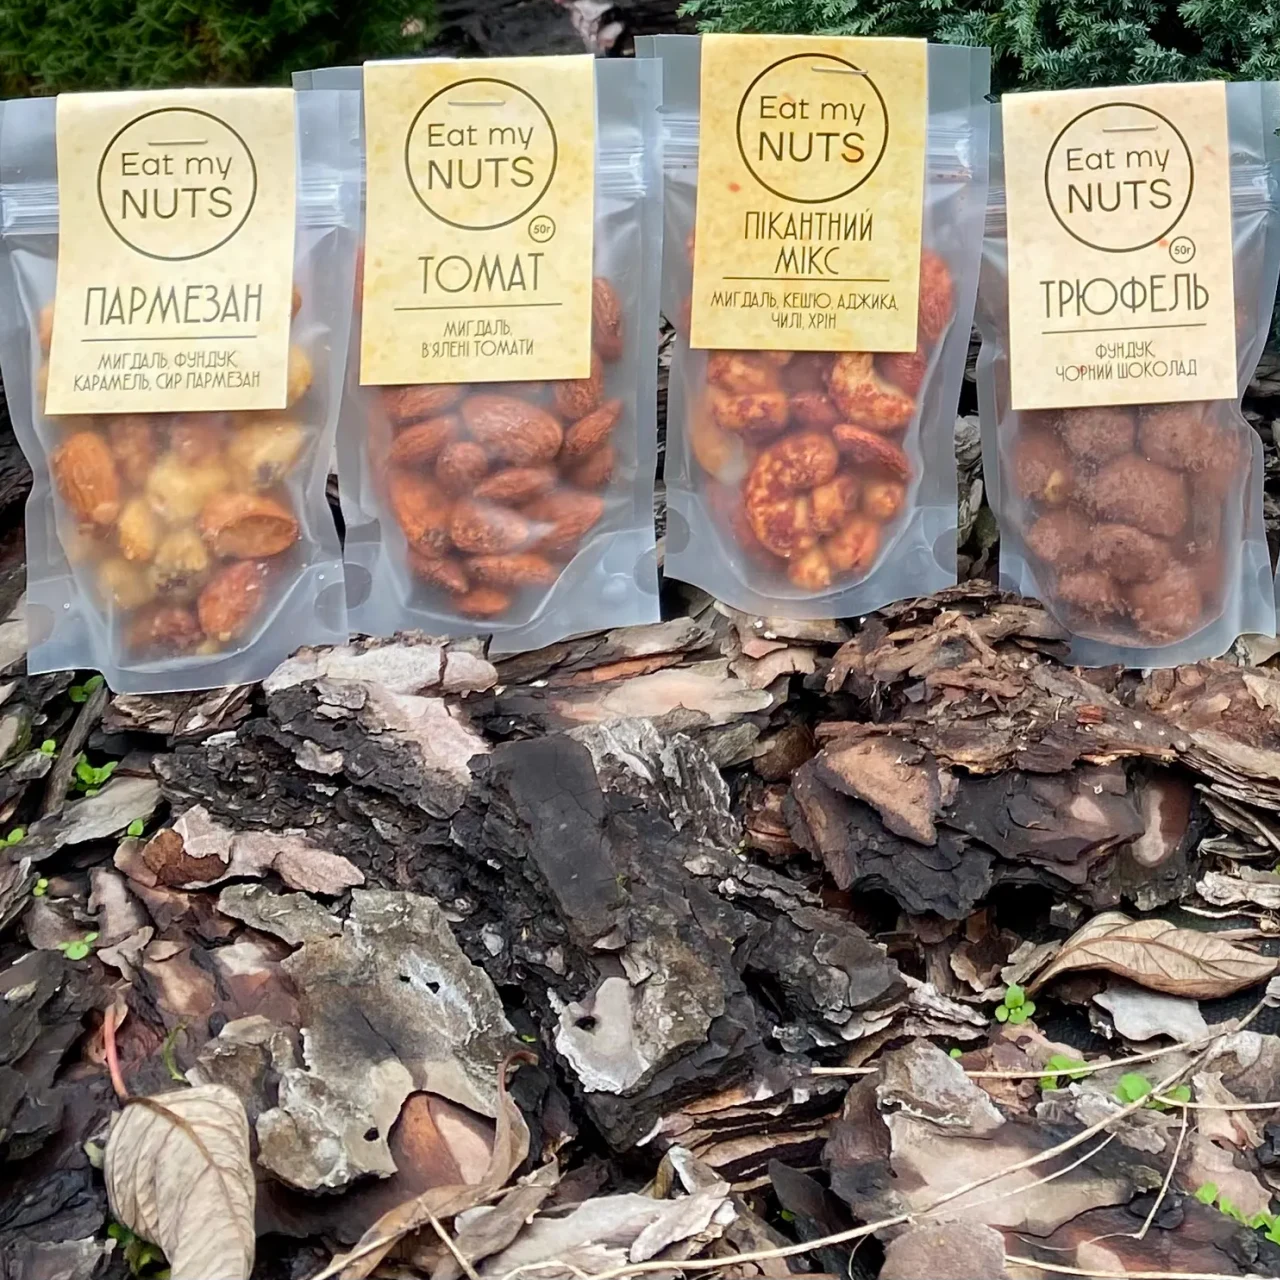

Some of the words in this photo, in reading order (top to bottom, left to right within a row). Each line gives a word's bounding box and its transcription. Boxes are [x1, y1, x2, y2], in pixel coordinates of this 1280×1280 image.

[760, 95, 809, 120] Eat
[821, 103, 866, 126] my
[428, 123, 477, 147] Eat
[489, 125, 534, 150] my
[759, 132, 865, 163] NUTS
[121, 152, 174, 176] Eat
[185, 156, 232, 180] my
[428, 156, 534, 190] NUTS
[1067, 148, 1115, 171] Eat
[1127, 149, 1170, 171] my
[121, 187, 233, 219] NUTS
[1068, 179, 1172, 213] NUTS
[534, 224, 551, 234] 50г
[744, 209, 874, 241] ПІКАНТНИЙ
[774, 246, 840, 275] МІКС
[1174, 246, 1191, 254] 50г
[418, 252, 544, 293] ТОМАТ
[84, 284, 263, 325] ПАРМЕЗАН
[710, 292, 779, 309] МИГДАЛЬ,
[837, 293, 899, 311] АДЖИКА,
[1040, 273, 1209, 318] ТРЮФЕЛЬ
[443, 319, 512, 337] МИГДАЛЬ,
[771, 313, 804, 330] ЧИЛІ,
[808, 313, 836, 329] ХРІН
[97, 352, 170, 370] МИГДАЛЬ,
[422, 341, 469, 358] В'ЯЛЕНІ
[474, 340, 534, 356] ТОМАТИ
[73, 373, 152, 392] КАРАМЕЛЬ,
[156, 372, 182, 390] СИР
[186, 371, 260, 389] ПАРМЕЗАН
[1056, 361, 1113, 382] ЧОРНИЙ
[1118, 359, 1197, 379] ШОКОЛАД
